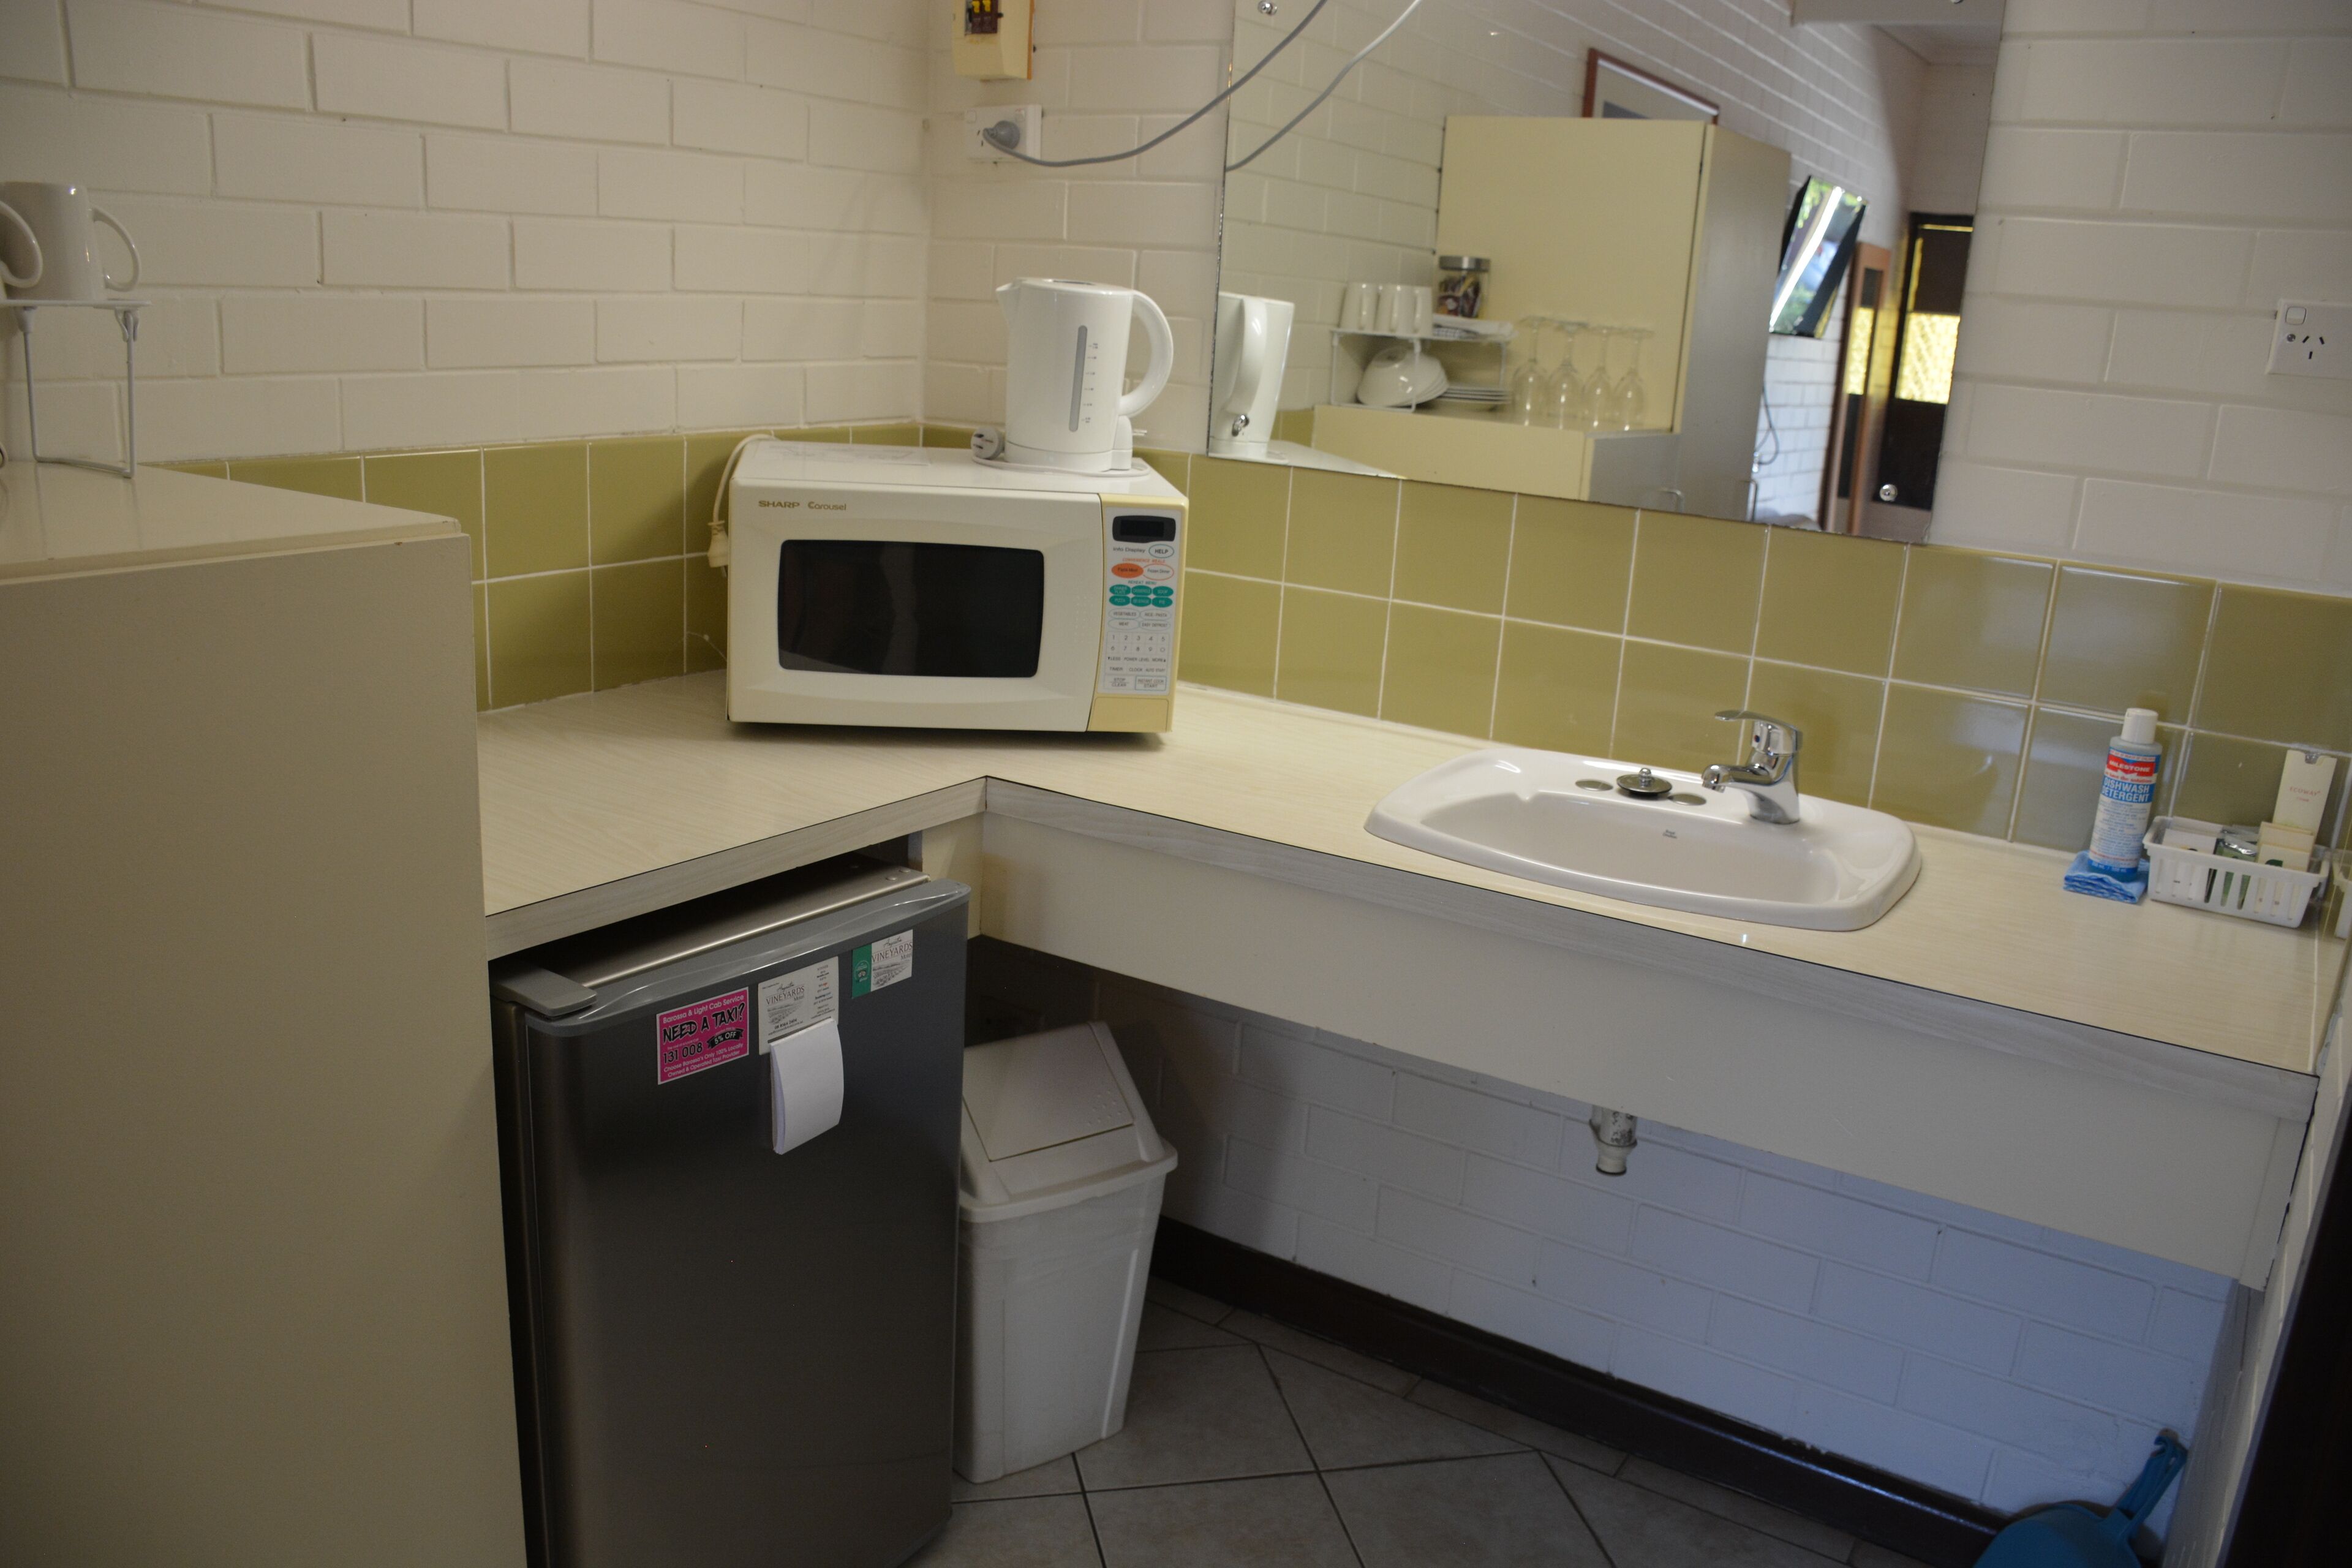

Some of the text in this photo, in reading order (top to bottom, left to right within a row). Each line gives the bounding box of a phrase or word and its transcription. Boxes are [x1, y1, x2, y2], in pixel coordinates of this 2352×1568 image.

[758, 500, 847, 511] SHARP Carousel
[2108, 760, 2150, 772] MILESTONE
[2101, 785, 2150, 802] DETERGENT
[2104, 777, 2150, 793] DISHWASH
[872, 941, 913, 962] VINEYARDS
[766, 986, 805, 1005] VINEYARDS
[663, 1013, 687, 1024] Barossa
[694, 1005, 708, 1015] Light
[709, 1001, 722, 1010] Cab
[723, 995, 744, 1006] Service
[663, 1020, 698, 1044] NEED
[701, 1016, 709, 1033] A
[712, 1002, 745, 1028] TAXI?
[714, 1031, 737, 1045] 5% OFF
[663, 1042, 703, 1065] 131 008
[663, 1064, 682, 1072] Choose
[683, 1057, 704, 1068] Barossa's
[704, 1052, 715, 1060] Only
[728, 1042, 744, 1052] Locally
[668, 1068, 685, 1077] Owned
[690, 1060, 712, 1071] Operated
[722, 1050, 741, 1060] Provider
